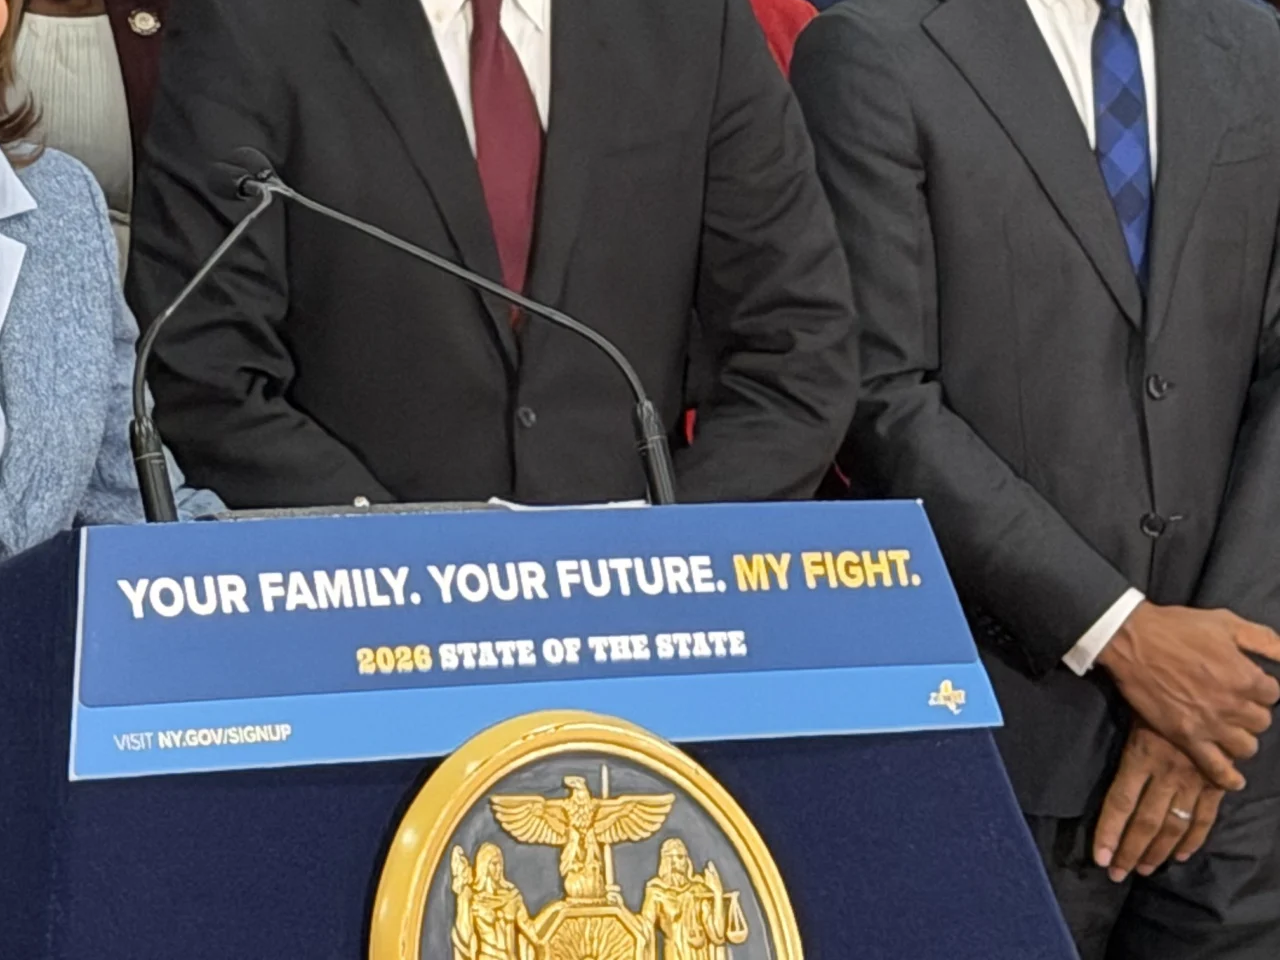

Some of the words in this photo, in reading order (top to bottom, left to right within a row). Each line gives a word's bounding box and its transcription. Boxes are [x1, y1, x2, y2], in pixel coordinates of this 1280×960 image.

[116, 573, 250, 620] YOUR
[258, 565, 422, 613] FAMILY.
[426, 561, 549, 604] YOUR
[555, 555, 727, 598] FUTURE.
[732, 552, 792, 592] MY
[801, 549, 922, 589] FIGHT.
[356, 644, 434, 675] 2026
[438, 639, 537, 671] STATE
[542, 637, 582, 665] OF
[588, 634, 651, 663] THE
[657, 630, 748, 660] STATE
[113, 731, 154, 752] VISIT
[157, 723, 293, 750] NY.GOV/SIGNUP
